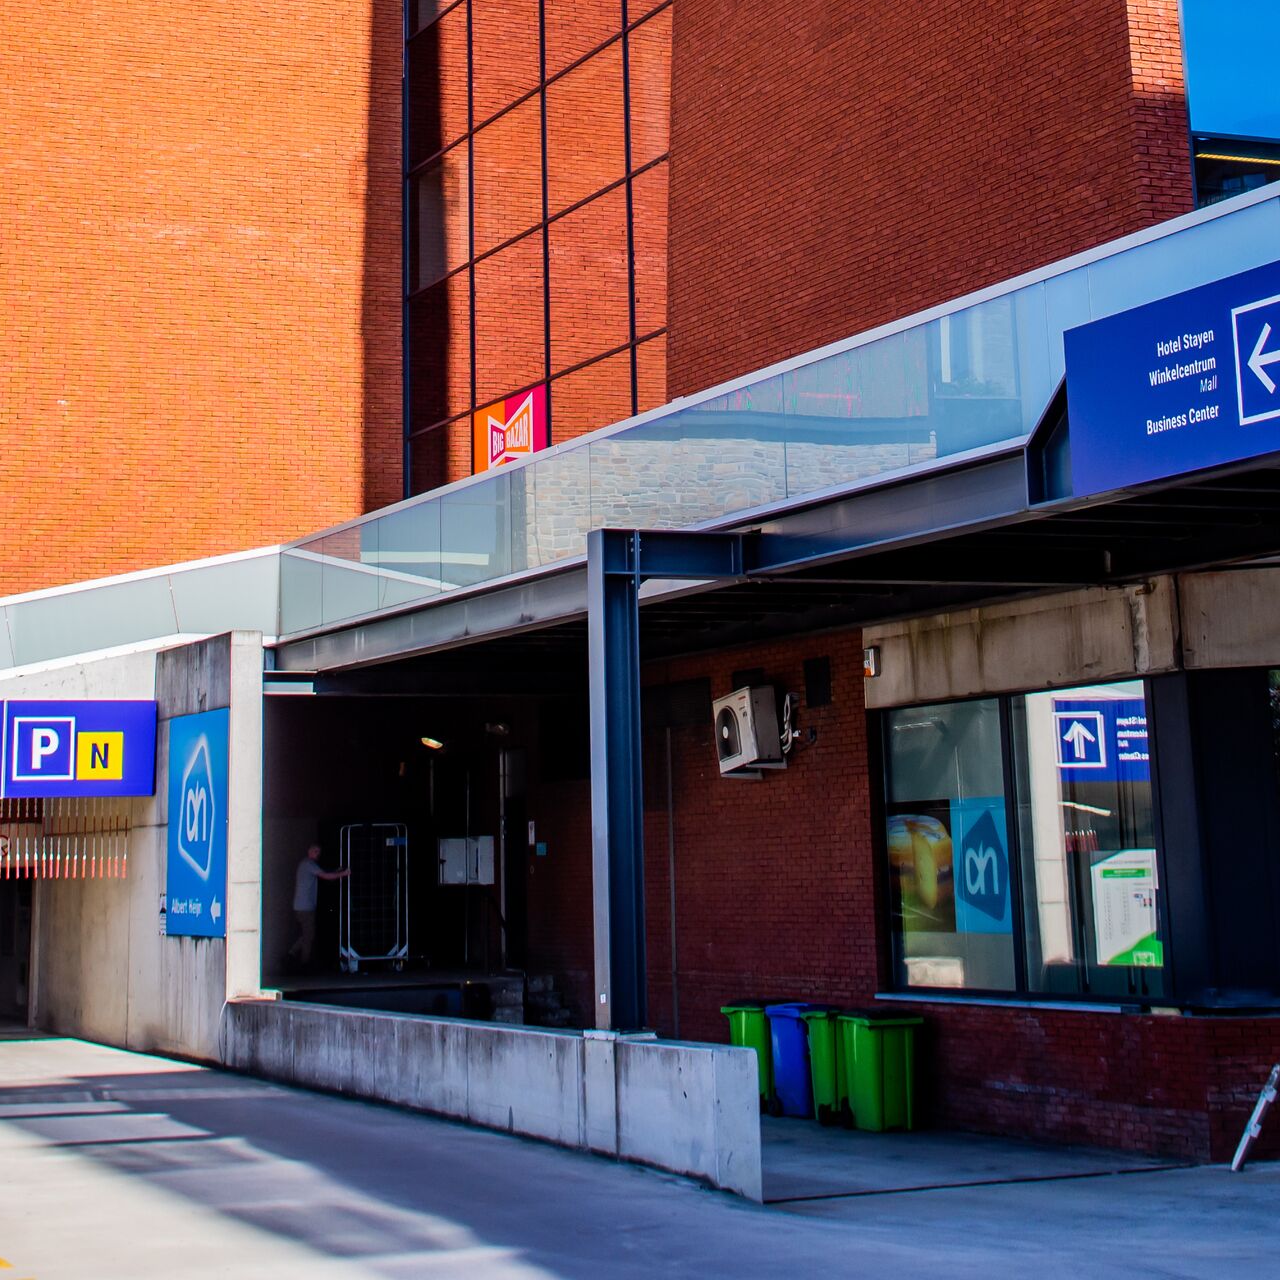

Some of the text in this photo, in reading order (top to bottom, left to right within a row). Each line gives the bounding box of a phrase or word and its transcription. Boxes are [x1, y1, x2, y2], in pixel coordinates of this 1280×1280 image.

[1157, 329, 1214, 357] Hotel Stayen
[1149, 356, 1216, 387] Winkelcentrum
[1200, 374, 1218, 393] Mall
[1146, 405, 1219, 435] Business Center
[492, 413, 529, 459] BIG BAZAR
[31, 727, 61, 770] P
[91, 742, 109, 770] N
[171, 898, 188, 915] Albert
